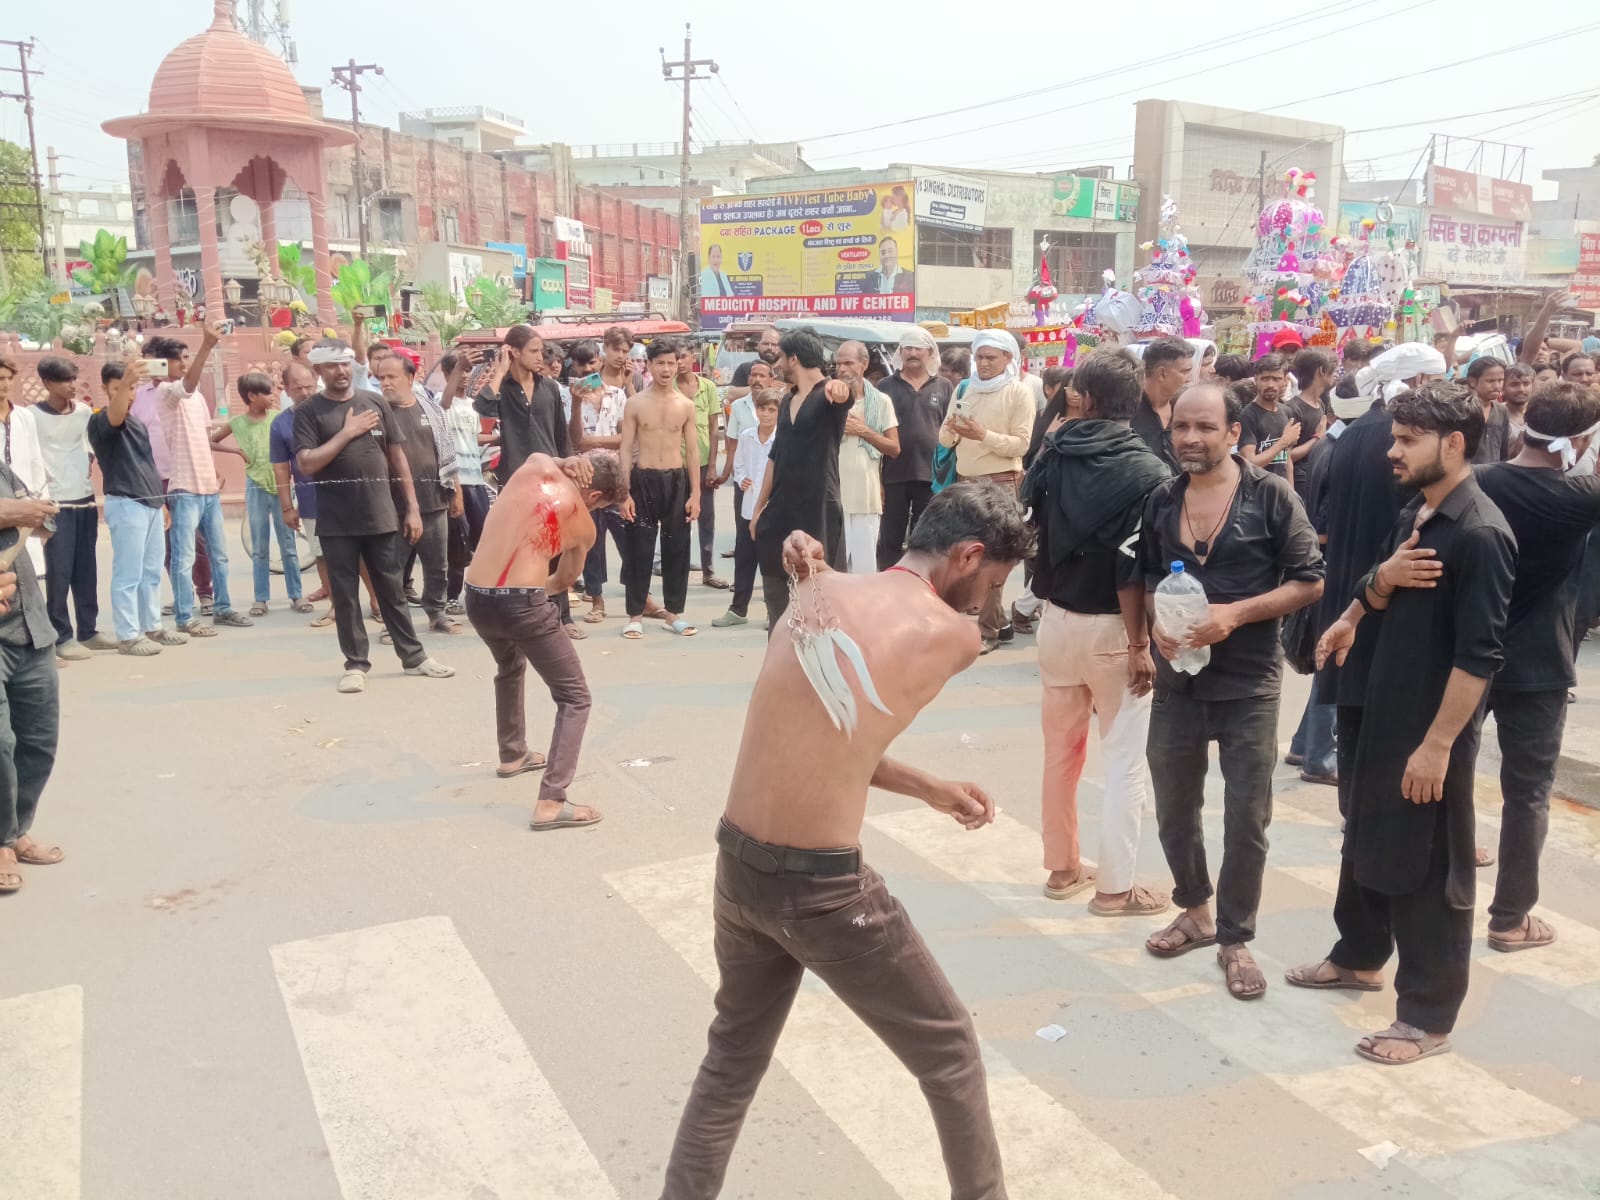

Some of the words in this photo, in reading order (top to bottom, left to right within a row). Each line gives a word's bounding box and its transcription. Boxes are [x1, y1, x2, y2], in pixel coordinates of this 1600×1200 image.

[783, 193, 820, 206] IVF/Test
[824, 192, 845, 204] Tube
[847, 190, 869, 203] Baby
[924, 179, 946, 197] SINGHAL
[948, 183, 984, 203] DISTRIBUTORS
[754, 225, 796, 236] PACKAGE
[541, 279, 563, 295] oppo
[704, 298, 756, 311] MEDICITY
[758, 298, 810, 311] HOSPITAL
[813, 297, 837, 311] AND
[841, 296, 860, 311] IVF
[863, 295, 909, 310] CENTER
